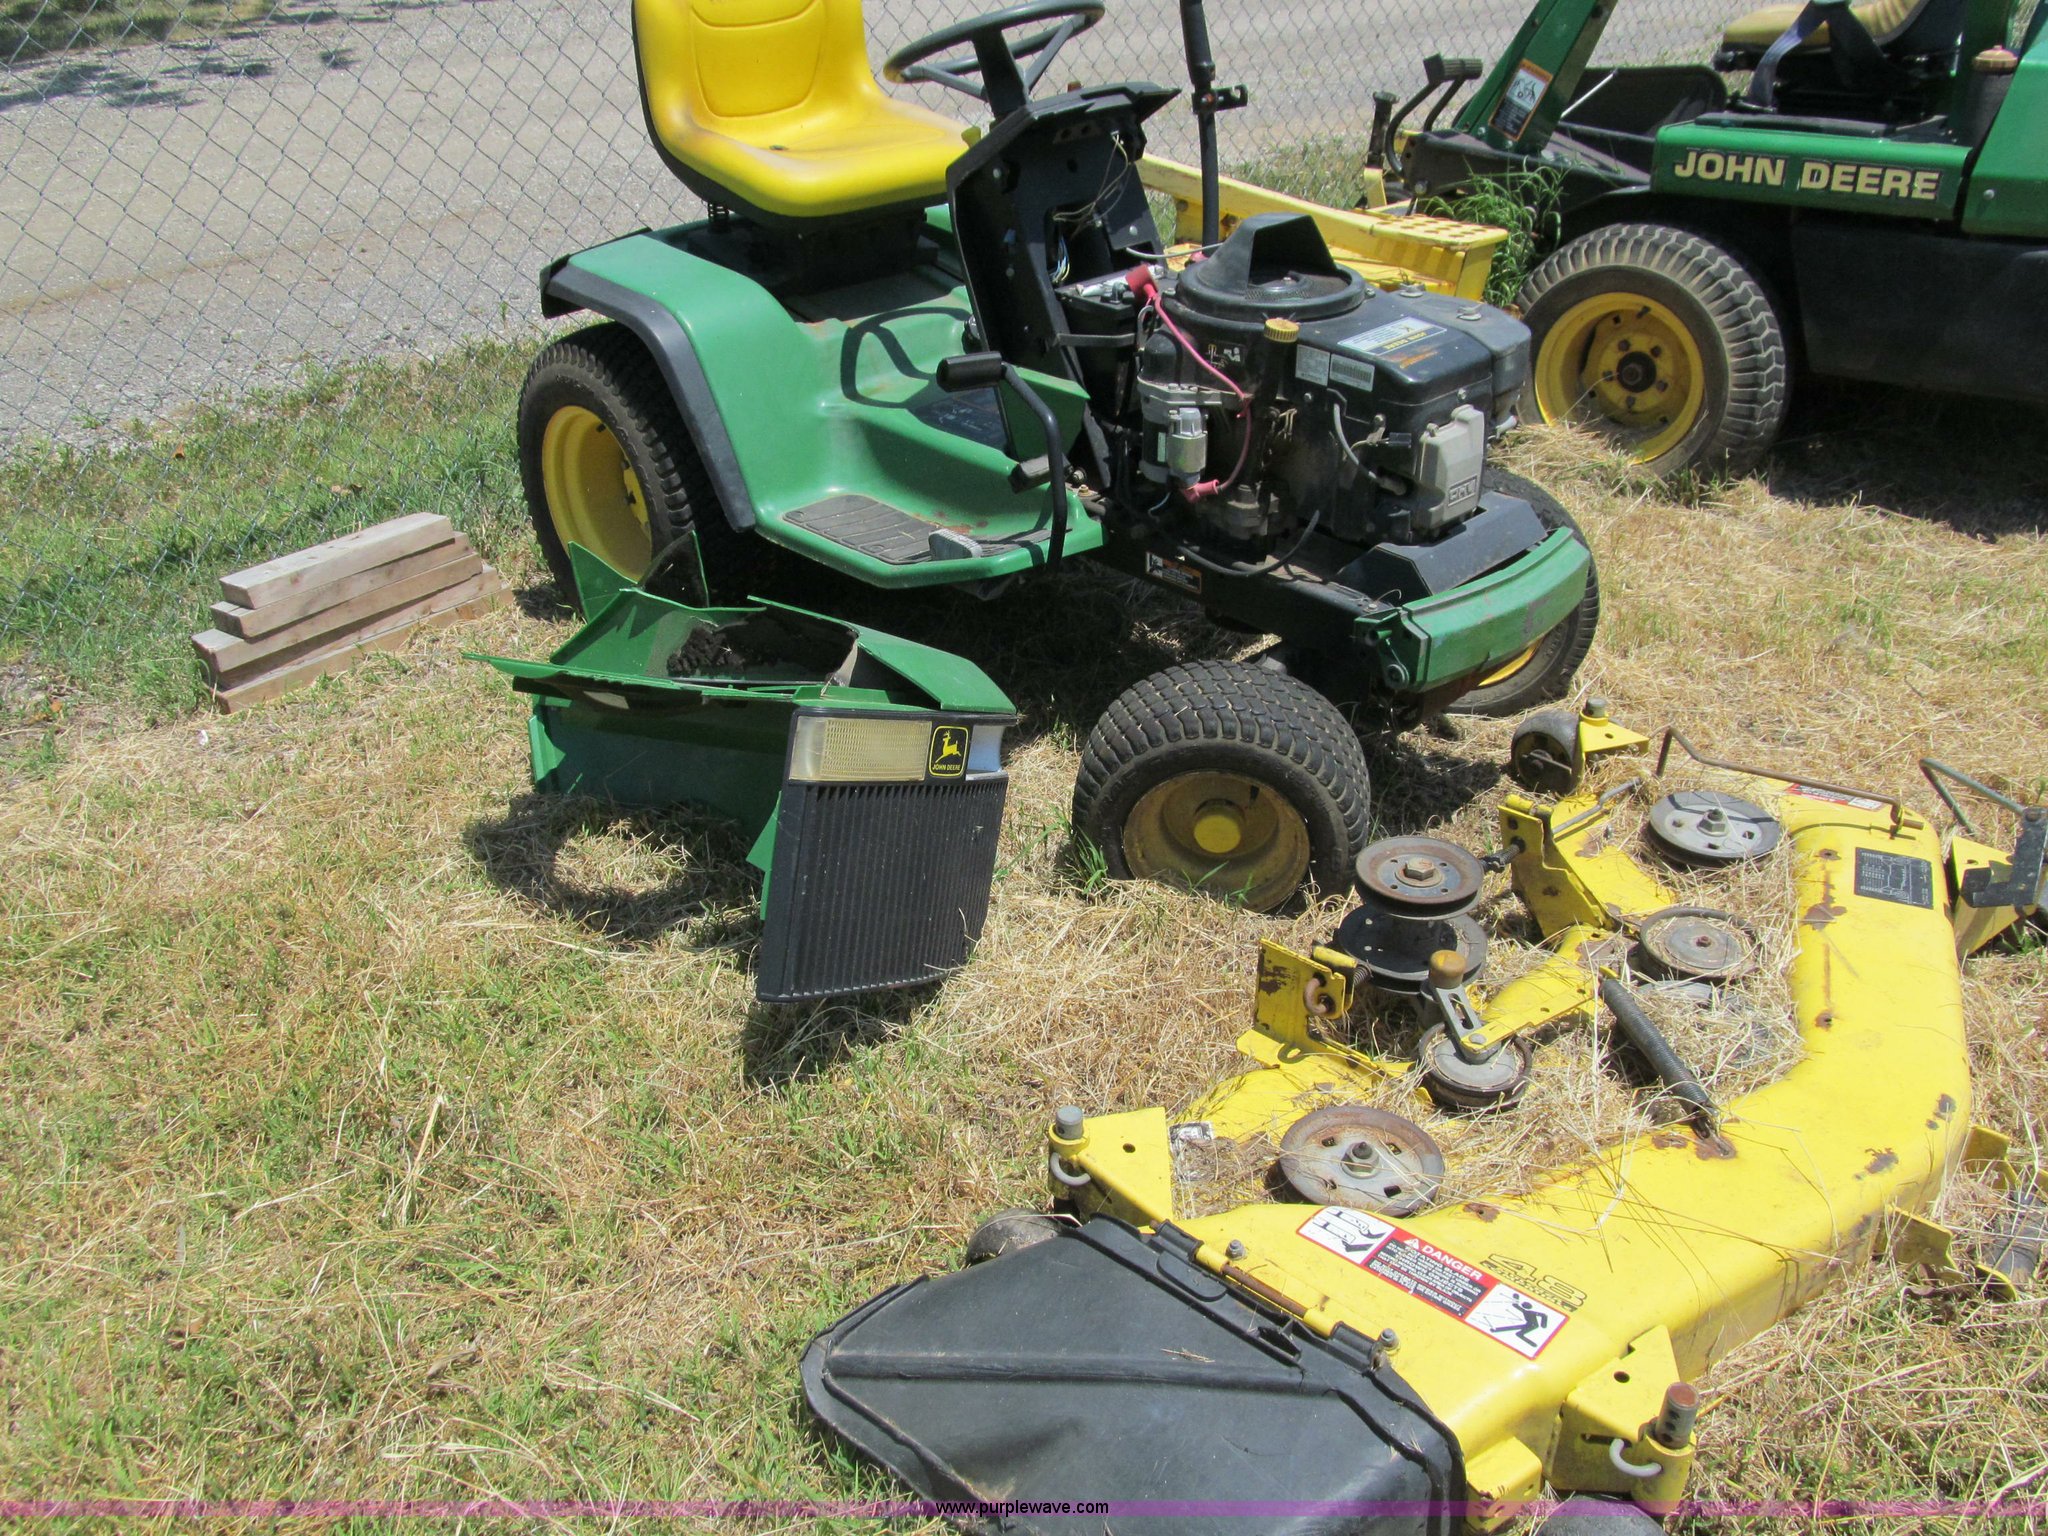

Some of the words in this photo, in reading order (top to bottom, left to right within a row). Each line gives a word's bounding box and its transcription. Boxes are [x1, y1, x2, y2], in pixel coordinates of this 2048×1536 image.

[1673, 149, 1787, 187] JOHN
[1801, 159, 1940, 201] DEERE
[1394, 1253, 1428, 1273] THROWN
[1427, 1271, 1464, 1292] OBJECTS
[1404, 1245, 1444, 1268] ROTATING
[1443, 1266, 1470, 1282] BLADE
[1420, 1244, 1483, 1280] DANGER
[1488, 1253, 1588, 1308] 48
